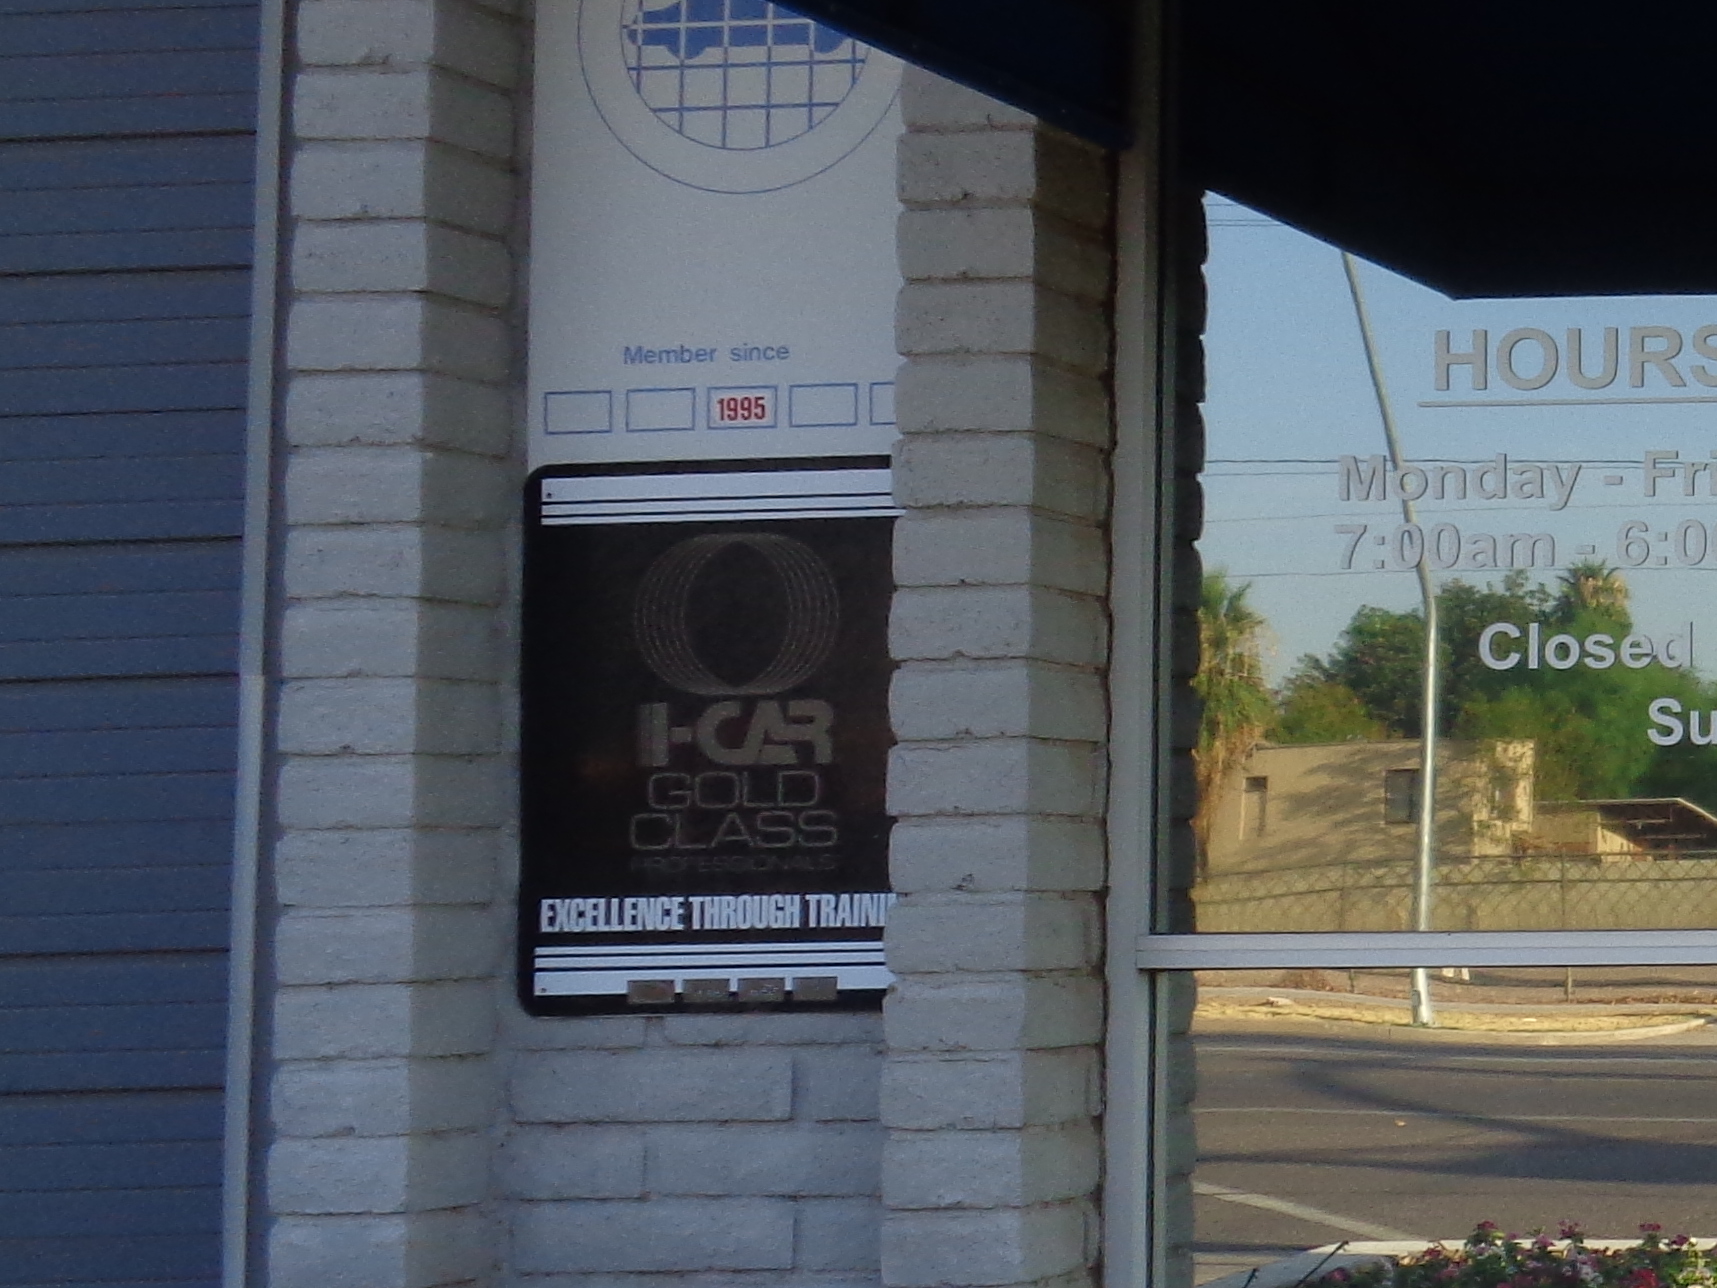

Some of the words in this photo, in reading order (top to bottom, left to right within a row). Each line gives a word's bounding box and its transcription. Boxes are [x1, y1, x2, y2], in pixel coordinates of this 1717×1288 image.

[623, 345, 717, 364] Member
[730, 343, 790, 362] since
[717, 396, 765, 421] 1995
[1338, 453, 1582, 510] Monday
[1335, 522, 1556, 570] 7:00am
[1478, 621, 1694, 671] Closed
[649, 771, 819, 809] GOLD
[630, 811, 837, 850] CLASS
[541, 897, 684, 932] EXCELLENCE
[689, 894, 800, 930] THROUGH
